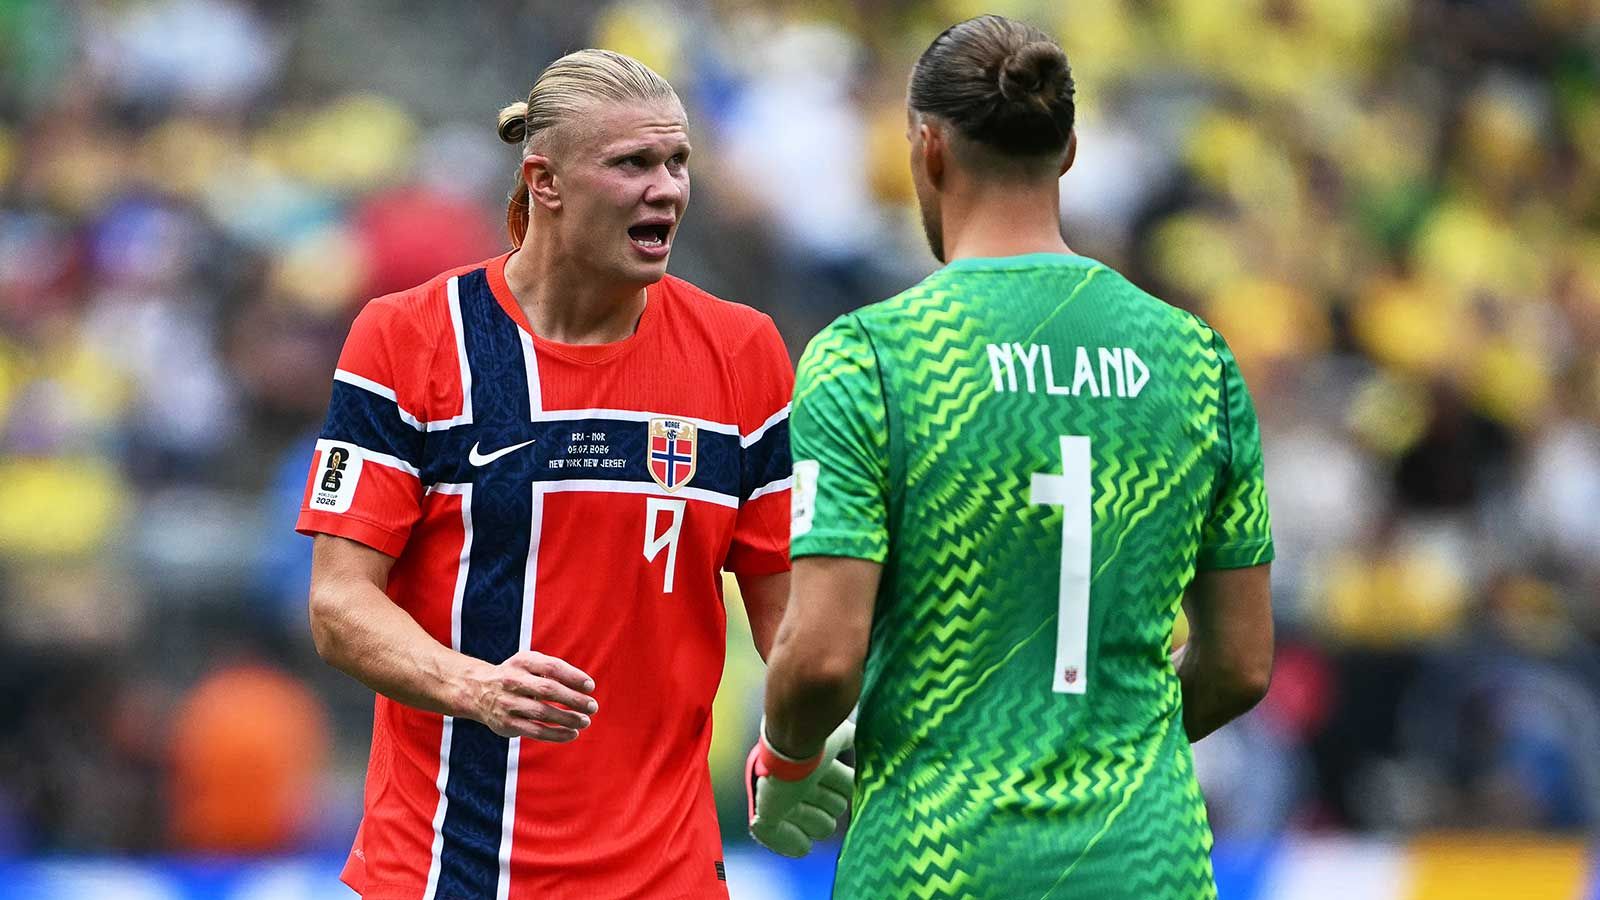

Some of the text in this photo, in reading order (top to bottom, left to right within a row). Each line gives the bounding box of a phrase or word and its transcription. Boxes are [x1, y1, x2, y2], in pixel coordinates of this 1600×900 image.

[986, 342, 1151, 398] NYLAND
[572, 433, 585, 442] BRA
[592, 432, 606, 442] NOR
[567, 445, 609, 455] 05.07.2026
[548, 458, 627, 469] NEW YORK NEW JERSEY
[316, 497, 336, 506] 2026
[643, 497, 687, 593] 9
[1030, 435, 1092, 695] 1
